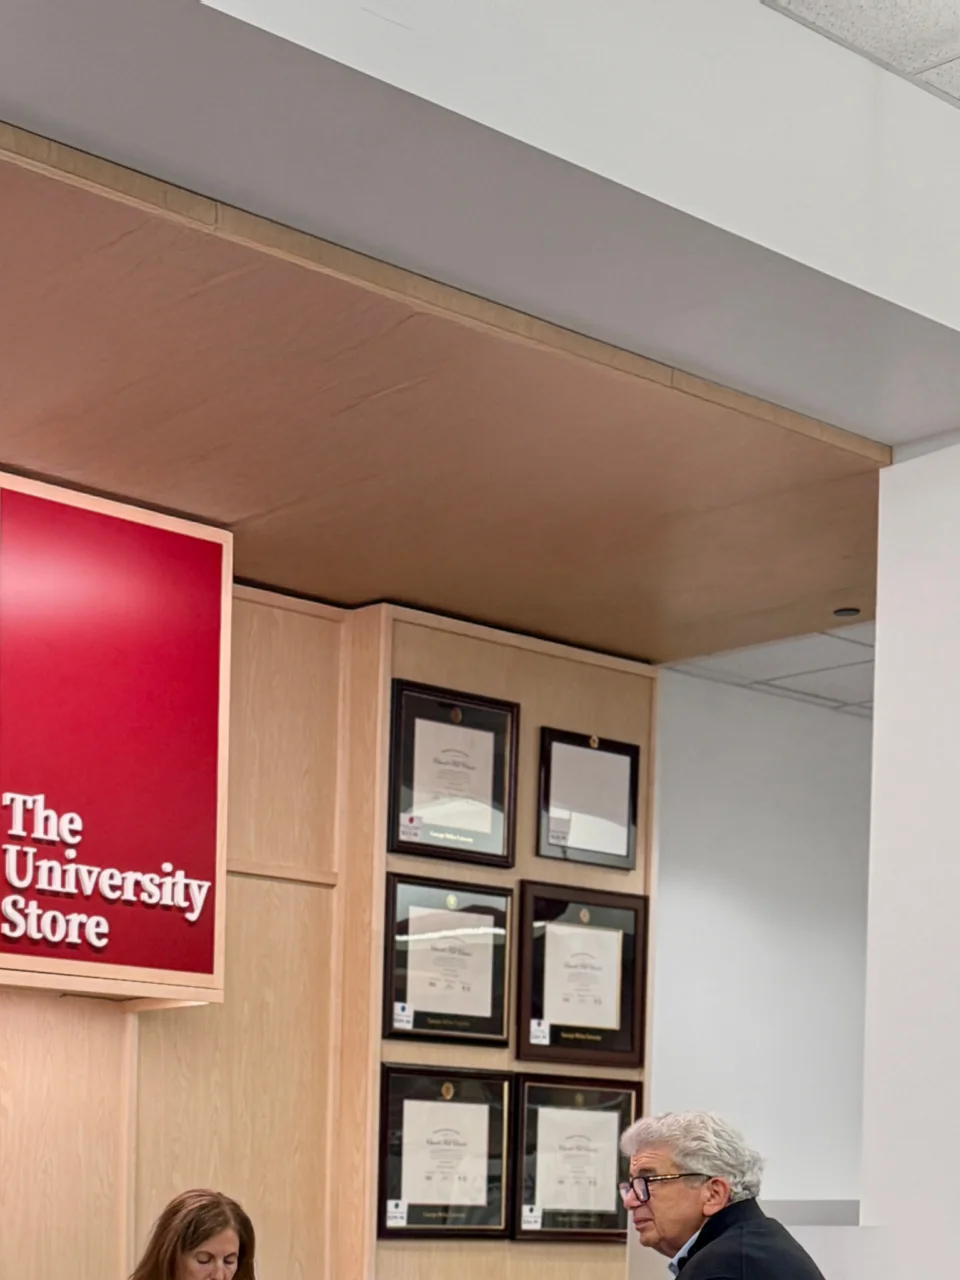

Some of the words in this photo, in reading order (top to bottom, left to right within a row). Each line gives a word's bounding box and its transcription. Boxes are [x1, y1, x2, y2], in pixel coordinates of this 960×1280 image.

[2, 791, 83, 845] The
[1, 844, 211, 922] University
[0, 894, 110, 948] Store
